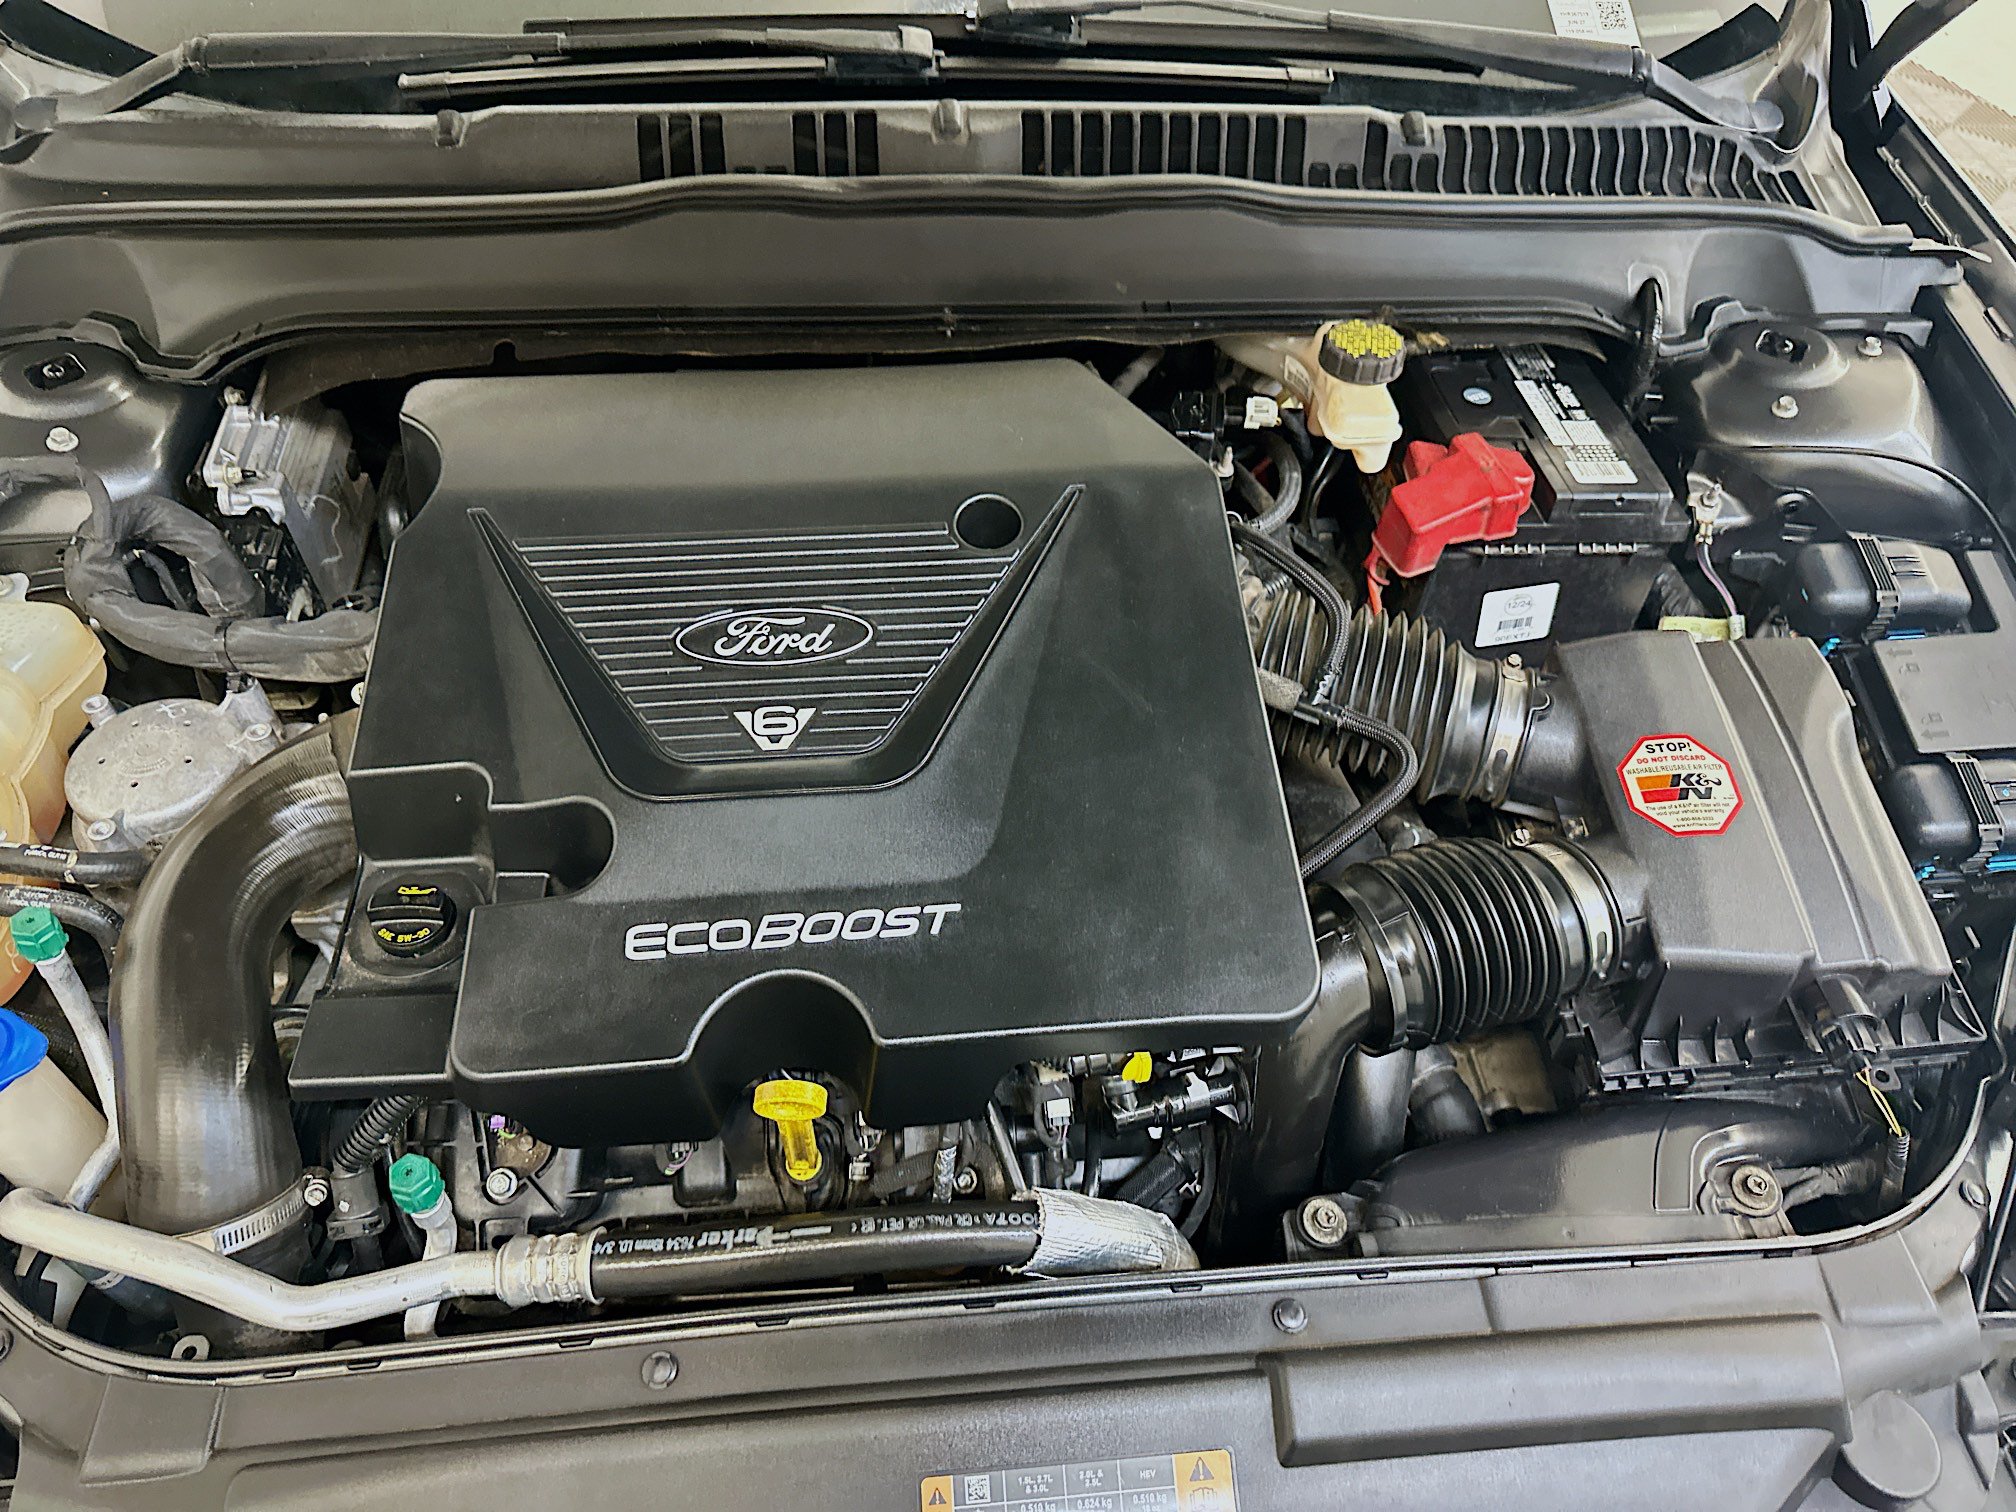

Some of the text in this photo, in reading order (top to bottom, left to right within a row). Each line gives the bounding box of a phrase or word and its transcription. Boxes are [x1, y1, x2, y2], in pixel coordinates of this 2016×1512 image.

[713, 615, 836, 657] Ford
[1645, 742, 1692, 754] STOP!
[1650, 755, 1669, 763] NOT
[1703, 763, 1723, 771] FILTER
[377, 927, 431, 943] SAE 5W-30
[624, 903, 962, 961] ECOBOOST
[696, 1225, 775, 1251] Parker
[1139, 1469, 1157, 1479] HEV
[1077, 1497, 1113, 1510] 0.624 kg
[1132, 1491, 1168, 1505] 0.510 kg
